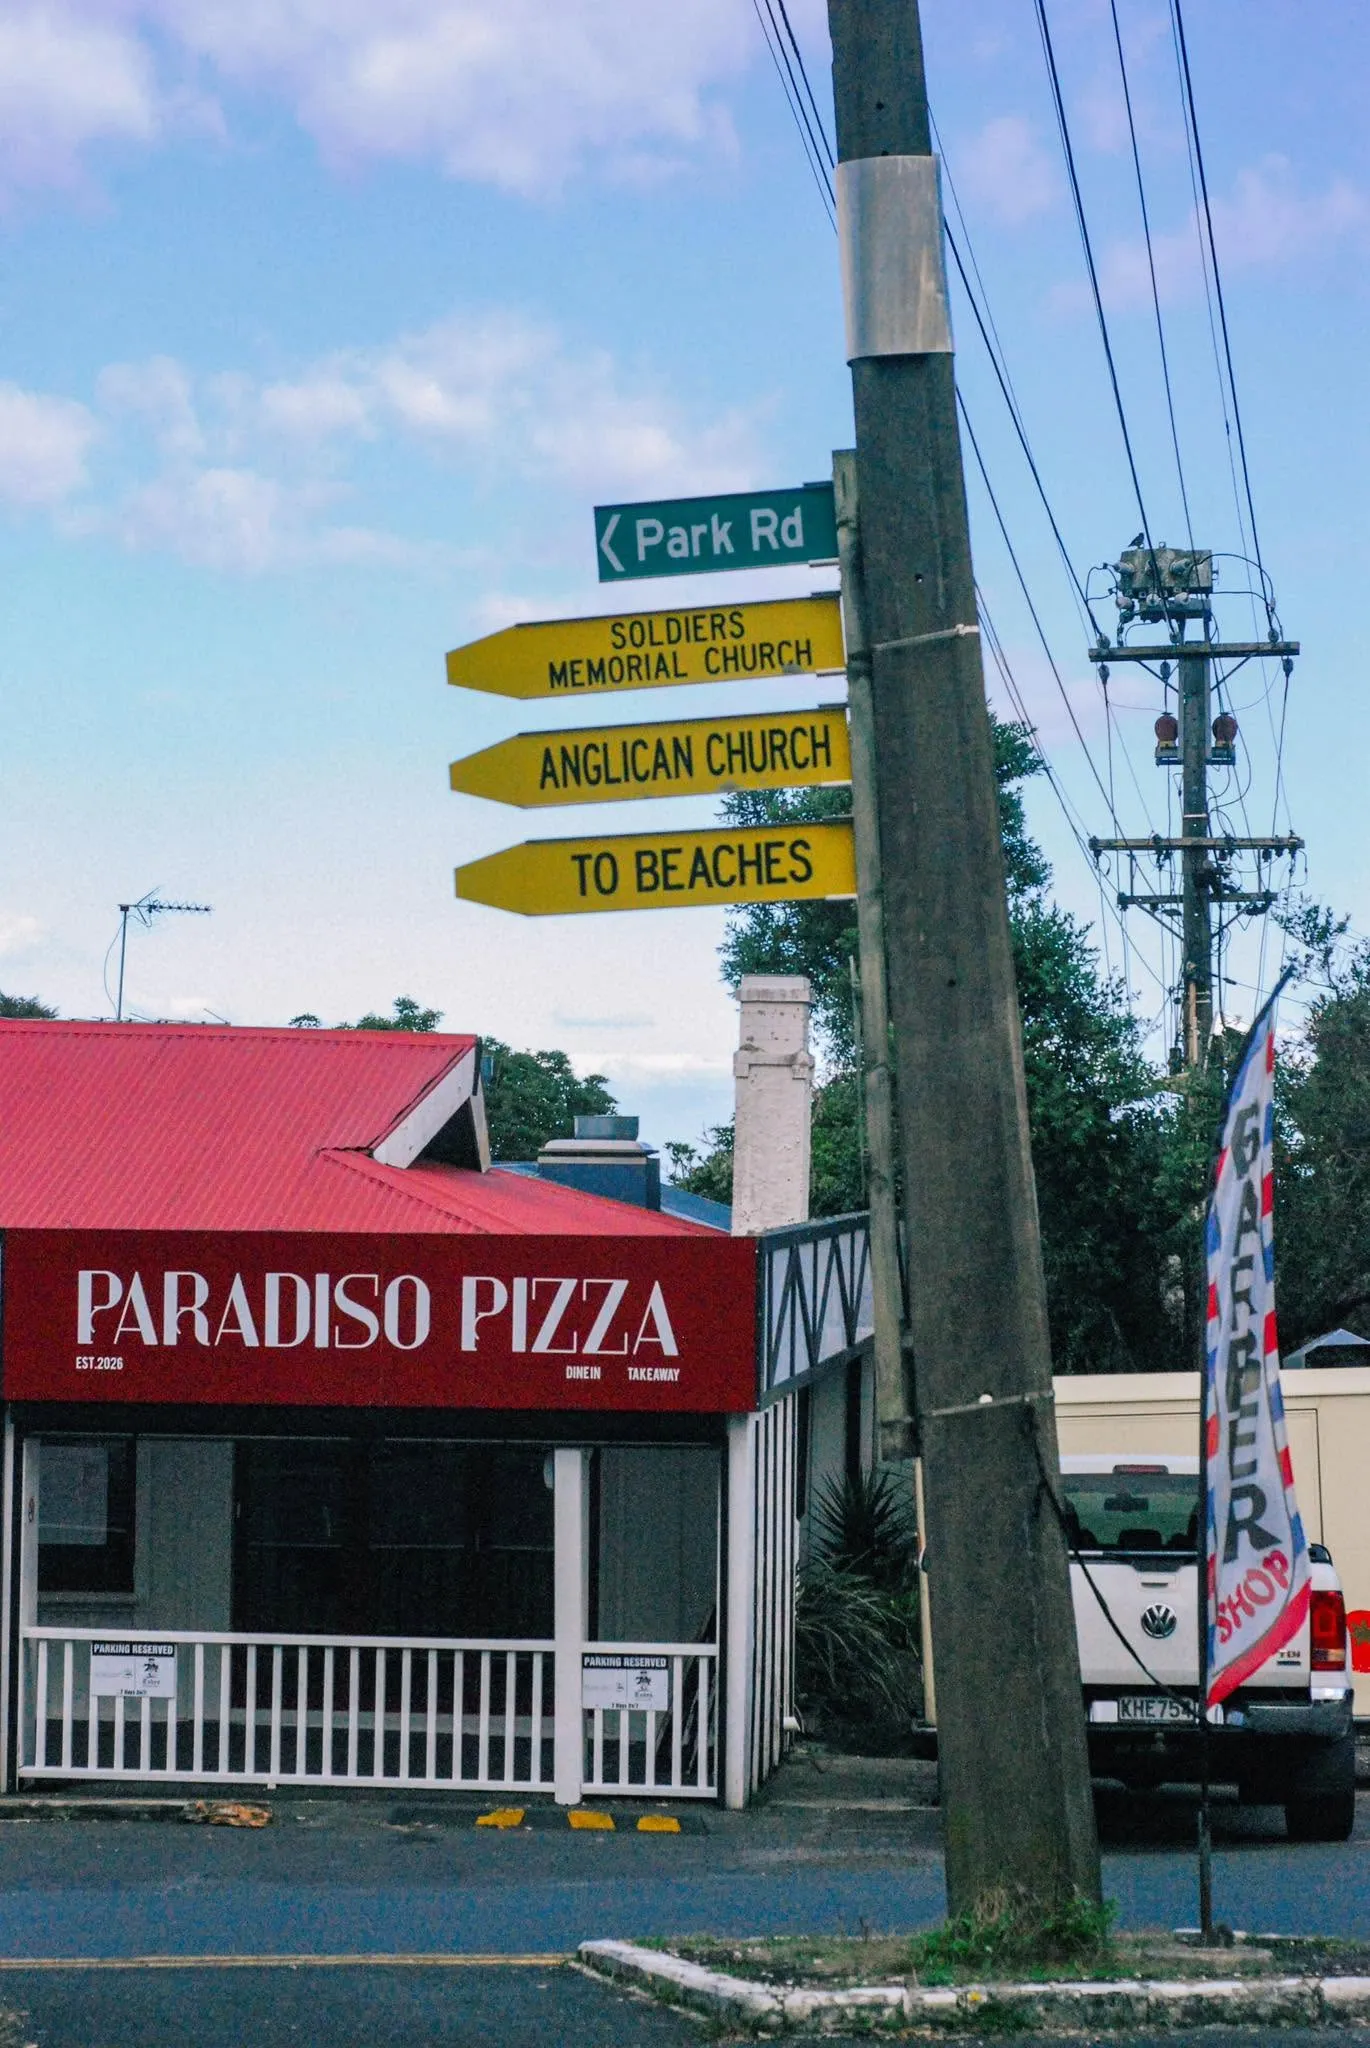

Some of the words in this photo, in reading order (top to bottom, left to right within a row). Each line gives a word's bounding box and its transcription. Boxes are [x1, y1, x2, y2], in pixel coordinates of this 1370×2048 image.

[636, 513, 734, 561] Park
[750, 505, 804, 551] Rd
[611, 612, 745, 650] SOLDIERS
[549, 650, 687, 689] MEMORIAL
[705, 639, 812, 676] CHURCH
[540, 736, 693, 790] ANGLICAN
[706, 725, 831, 777] CHURCH
[571, 852, 619, 896] TO
[635, 839, 813, 893] BEACHES
[77, 1270, 430, 1350] PARADISO
[462, 1276, 679, 1357] PIZZA
[628, 1367, 680, 1381] TAKEAWAY
[1216, 1550, 1289, 1643] SHOP
[93, 1643, 130, 1655] PARKING
[132, 1645, 173, 1655] RESERVED
[584, 1656, 622, 1667] PARKING
[623, 1657, 667, 1668] RESERVED
